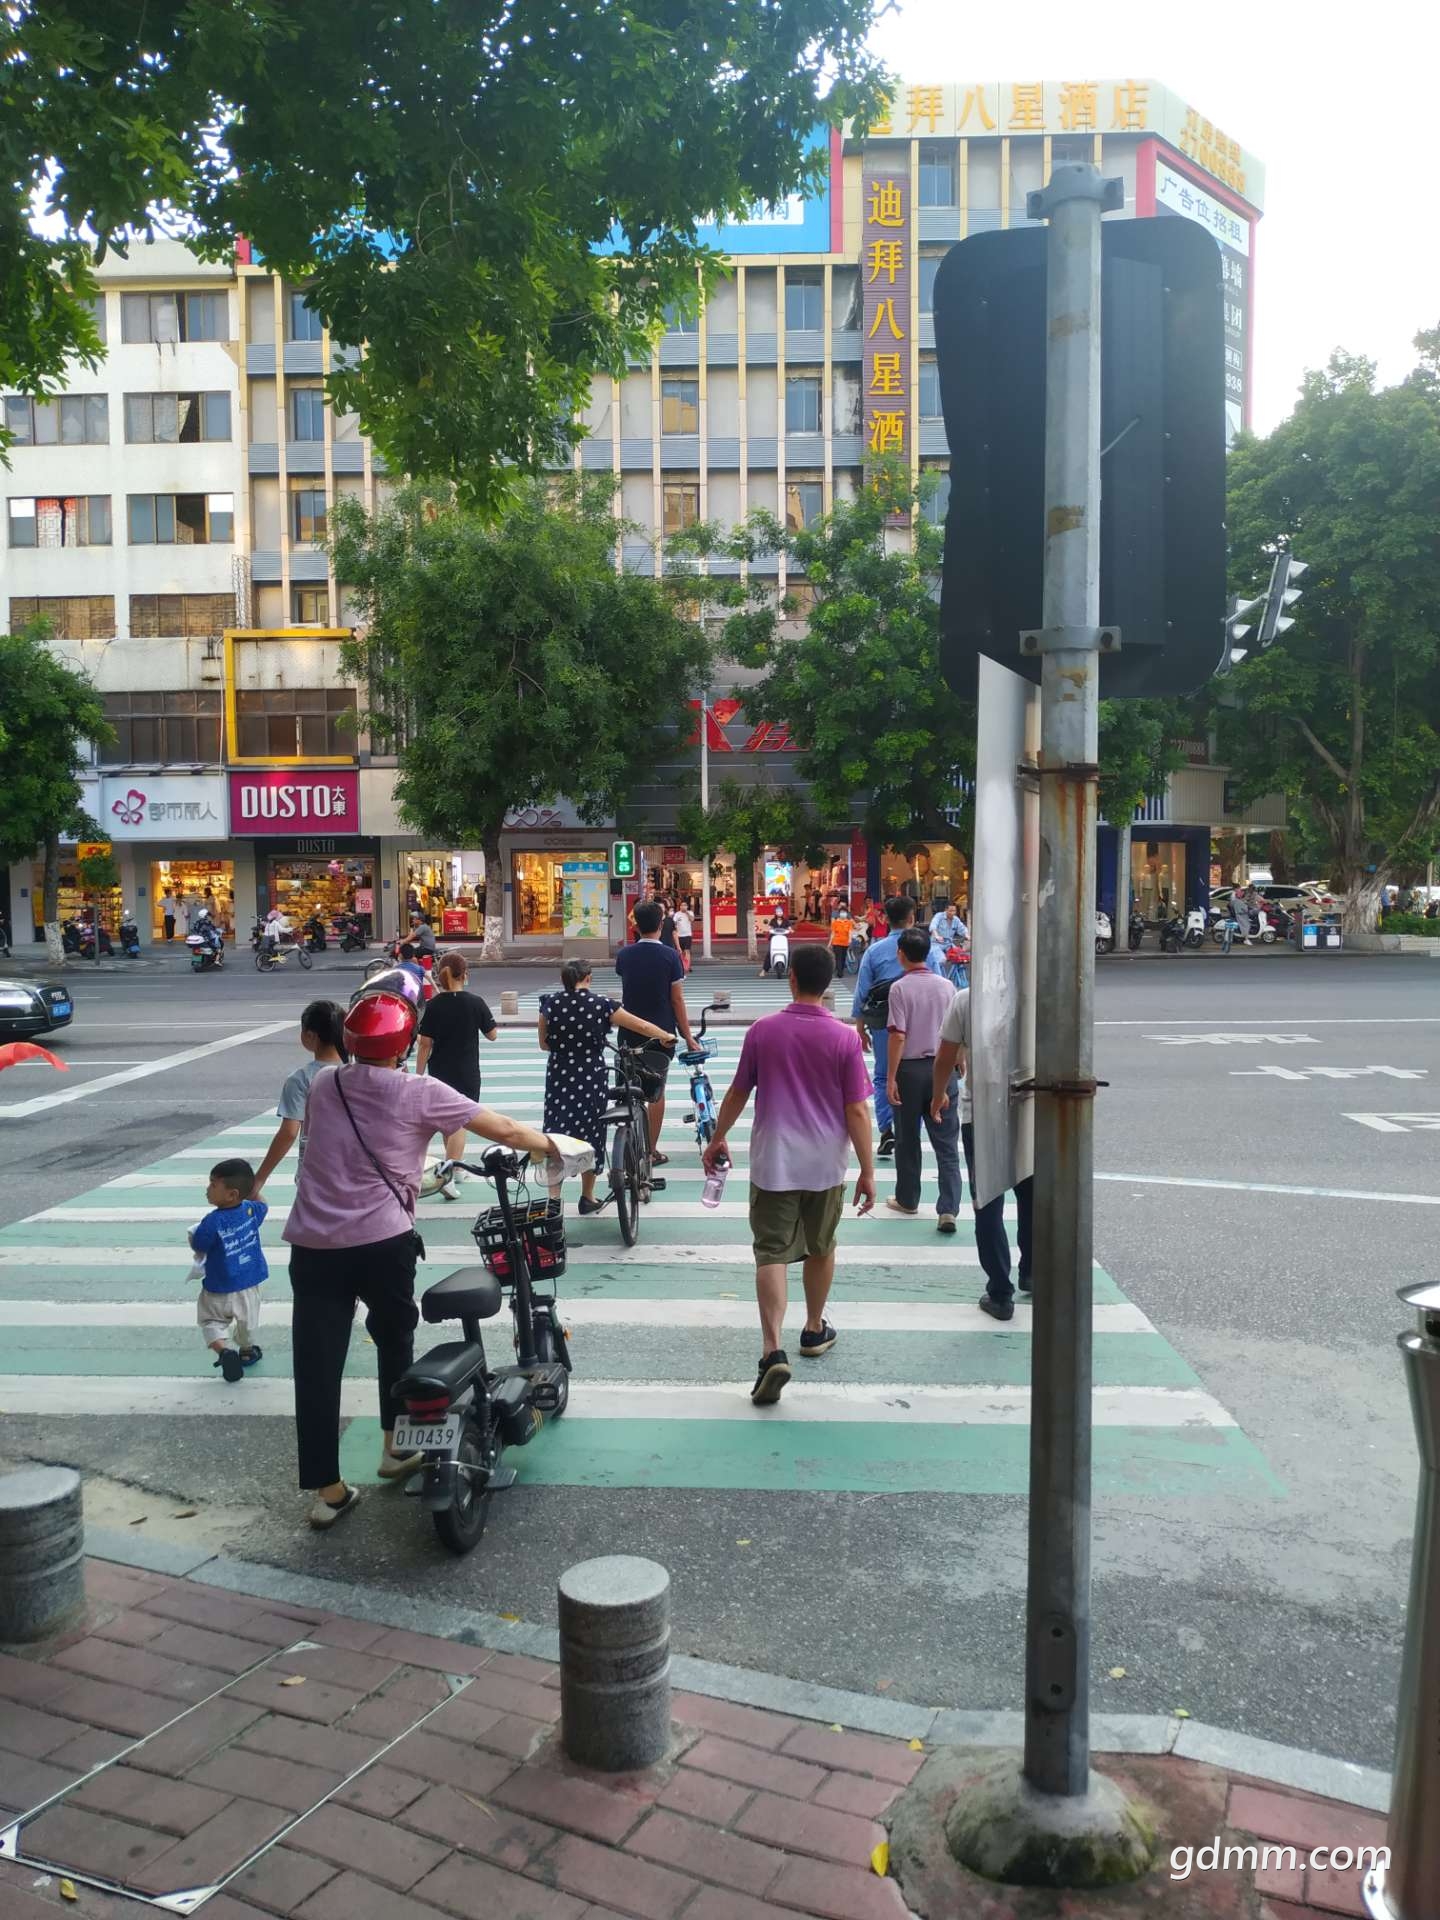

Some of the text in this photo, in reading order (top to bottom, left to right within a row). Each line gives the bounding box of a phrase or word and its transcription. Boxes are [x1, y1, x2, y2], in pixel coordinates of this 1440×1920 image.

[1160, 176, 1242, 243] 广告位招租
[240, 784, 331, 819] DUSTO
[297, 839, 336, 854] DUSTO
[396, 1429, 454, 1446] 010439
